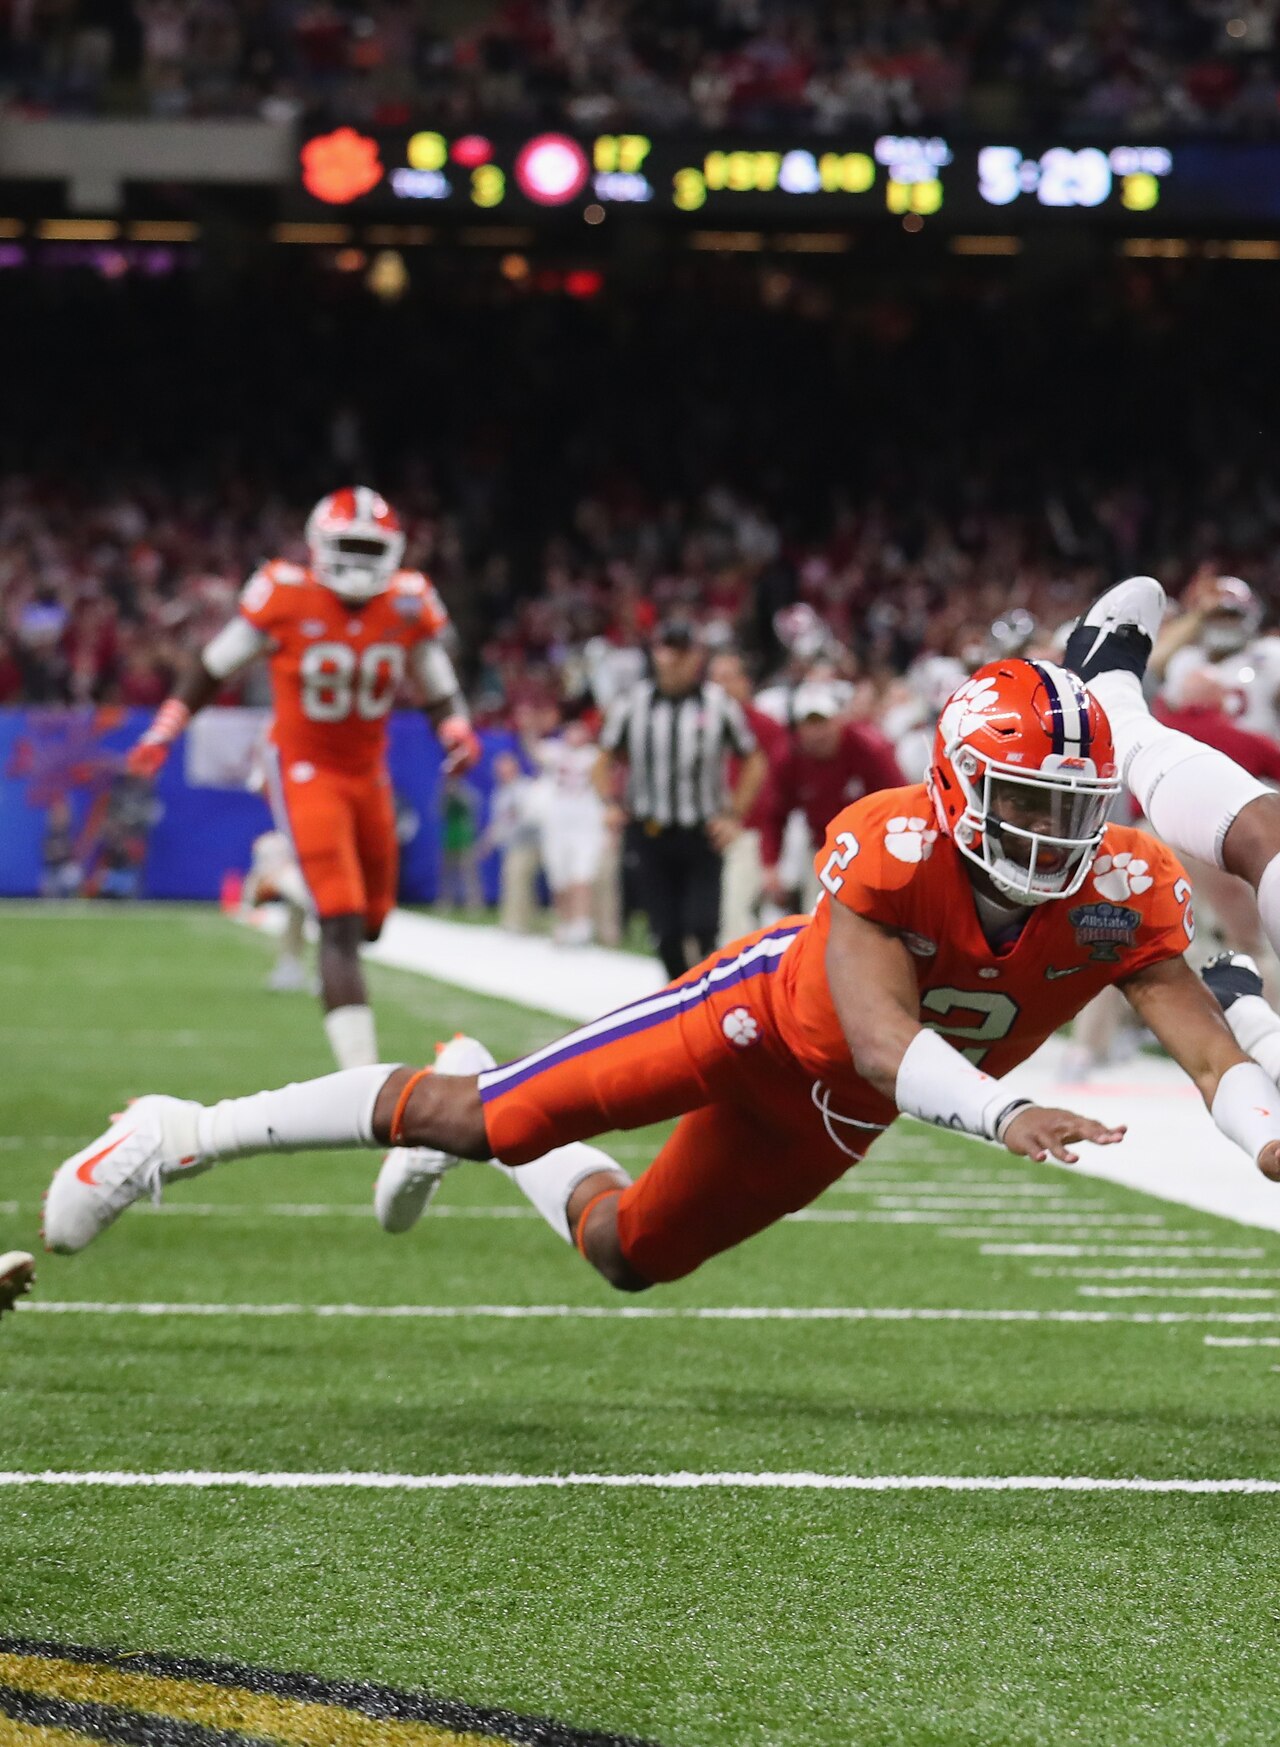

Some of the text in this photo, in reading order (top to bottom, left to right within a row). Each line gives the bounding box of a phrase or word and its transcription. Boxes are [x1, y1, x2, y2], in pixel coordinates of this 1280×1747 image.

[301, 641, 406, 722] 80
[819, 831, 859, 896] 2
[1080, 914, 1128, 929] Allstate
[922, 988, 1018, 1067] 2
